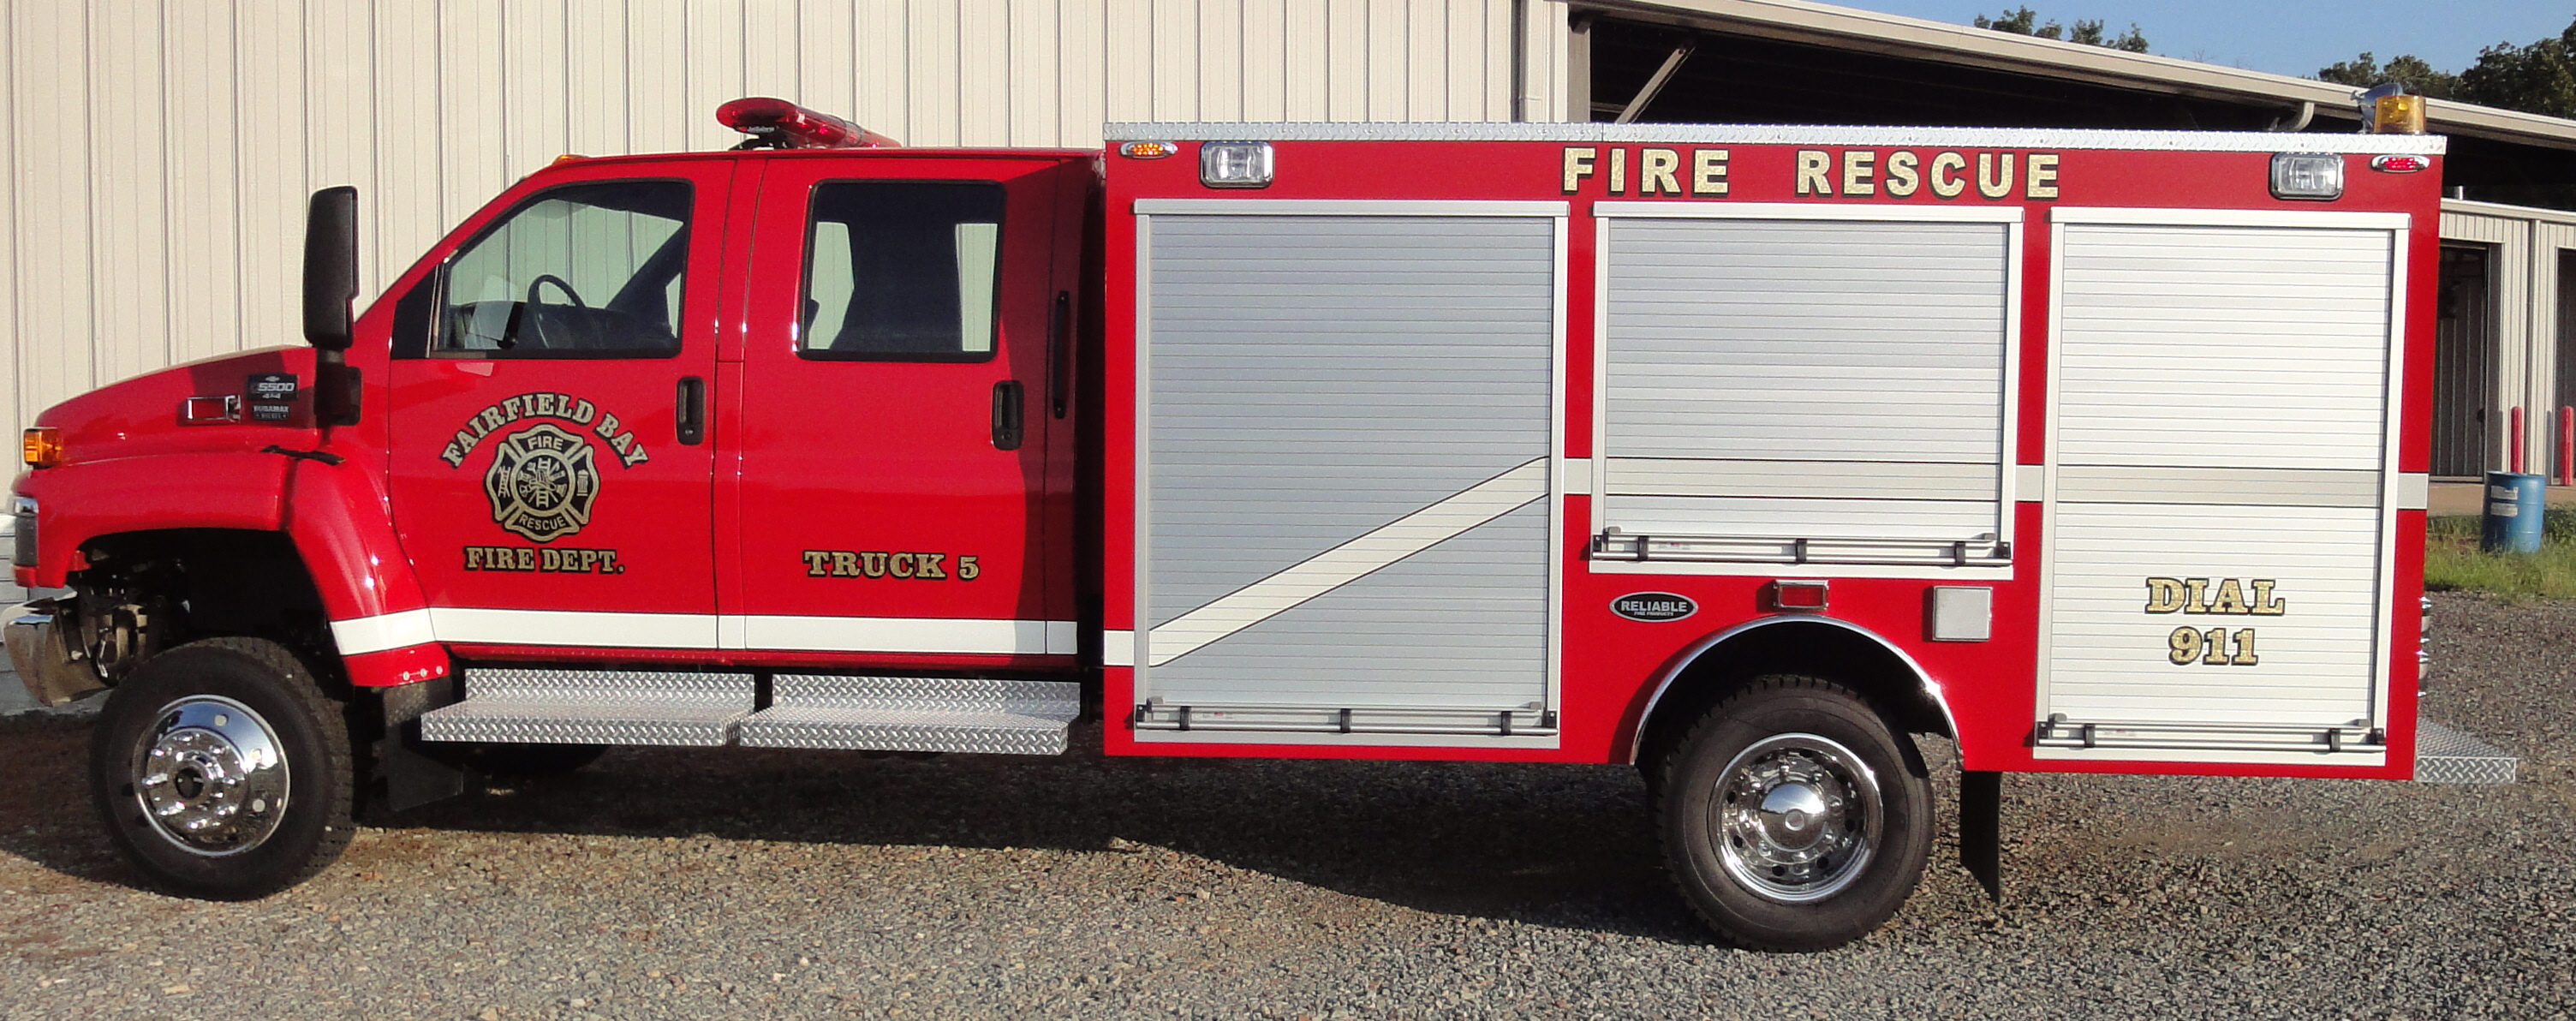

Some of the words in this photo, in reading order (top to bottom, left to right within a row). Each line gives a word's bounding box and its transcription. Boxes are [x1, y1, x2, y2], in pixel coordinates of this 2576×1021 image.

[1562, 146, 1731, 195] FIRE
[1797, 150, 2060, 200] RESCUE
[440, 392, 595, 469] FAIRFIELD
[594, 412, 649, 469] BAY
[528, 435, 564, 451] FIRE
[518, 513, 566, 531] RESCUE
[464, 546, 536, 571] FIRE
[540, 548, 626, 574] DEPT.
[802, 550, 947, 580] TRUCK
[957, 555, 981, 582] 5
[1620, 600, 1688, 612] RELIABLE
[2145, 577, 2286, 615] DIAL
[2168, 626, 2258, 666] 911
